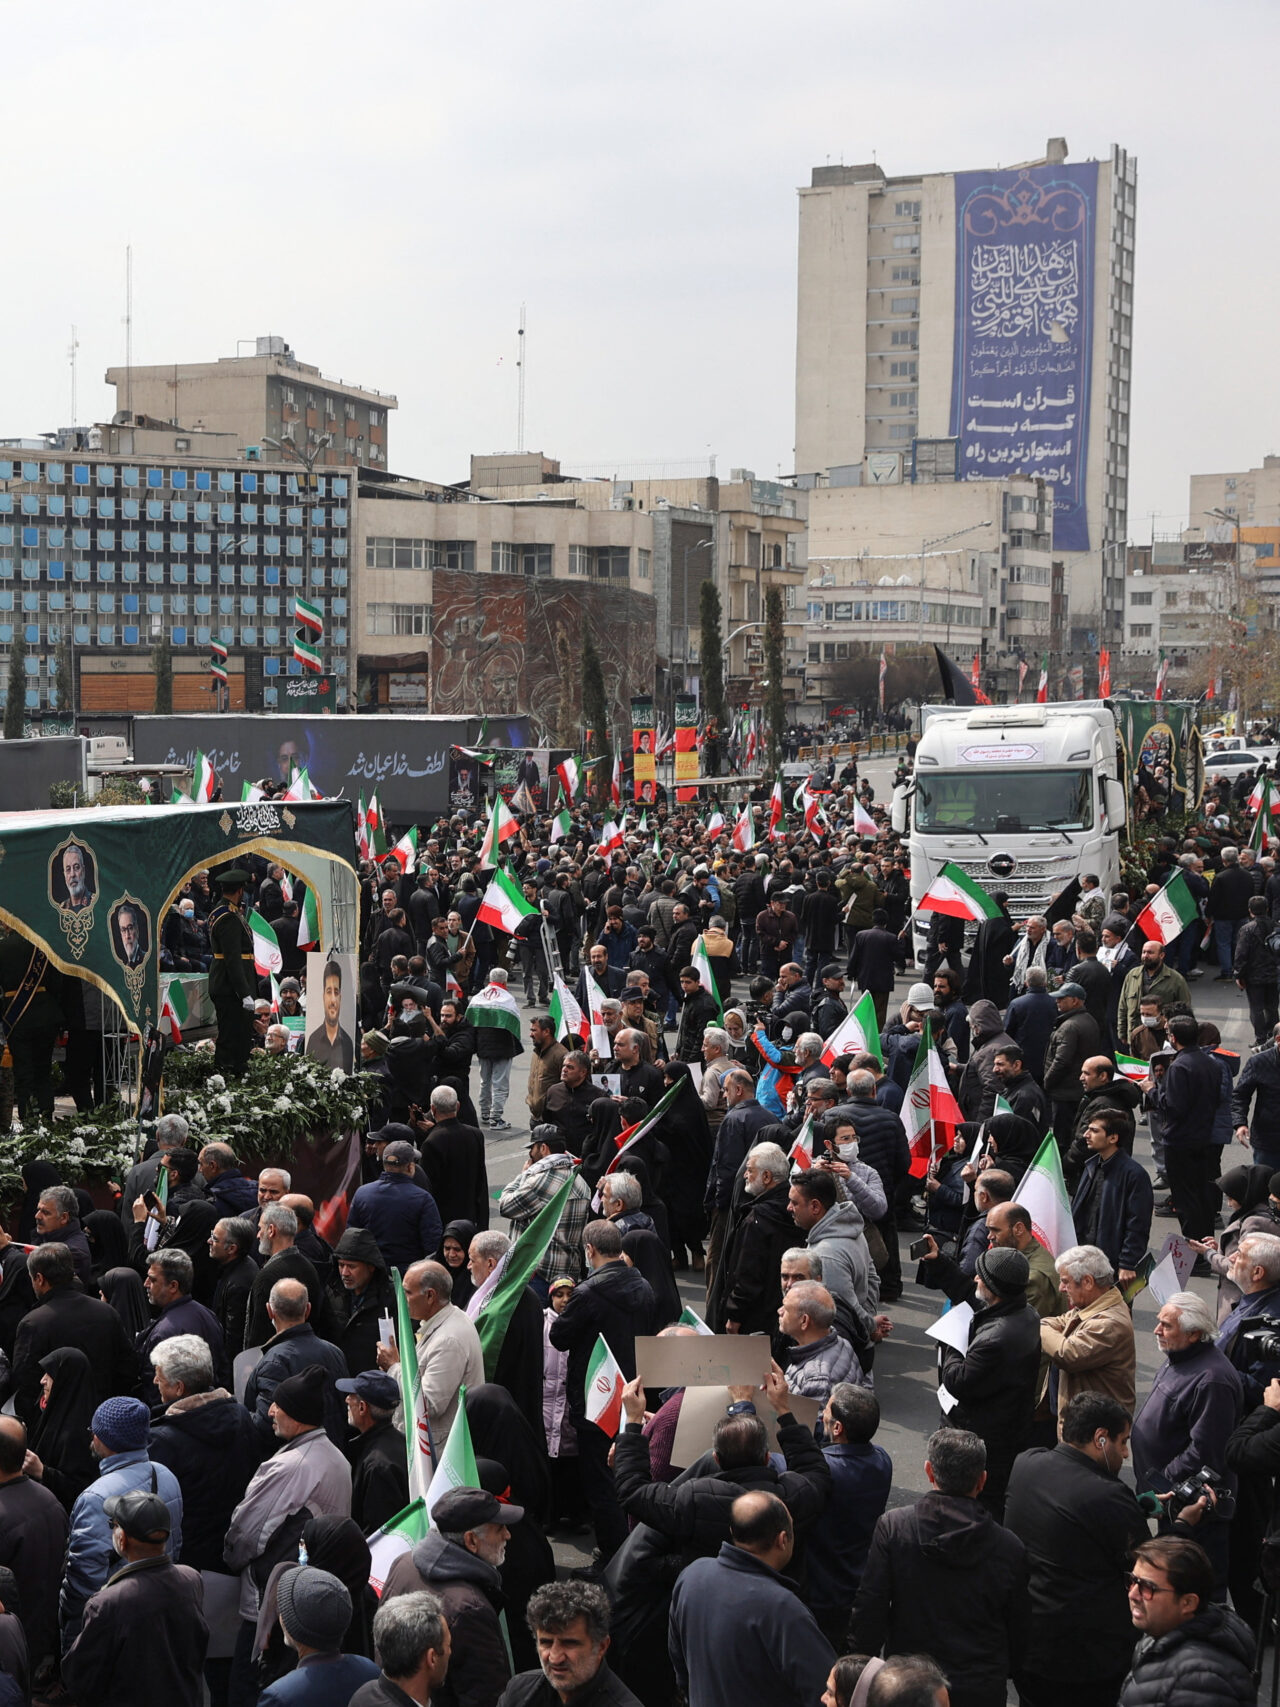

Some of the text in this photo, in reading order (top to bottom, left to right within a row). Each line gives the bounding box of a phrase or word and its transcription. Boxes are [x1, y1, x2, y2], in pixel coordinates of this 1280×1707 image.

[967, 384, 1075, 411] قرآن است
[966, 417, 1019, 436] به
[966, 442, 986, 463] راه
[345, 750, 446, 782] لطف خدا عیان شد
